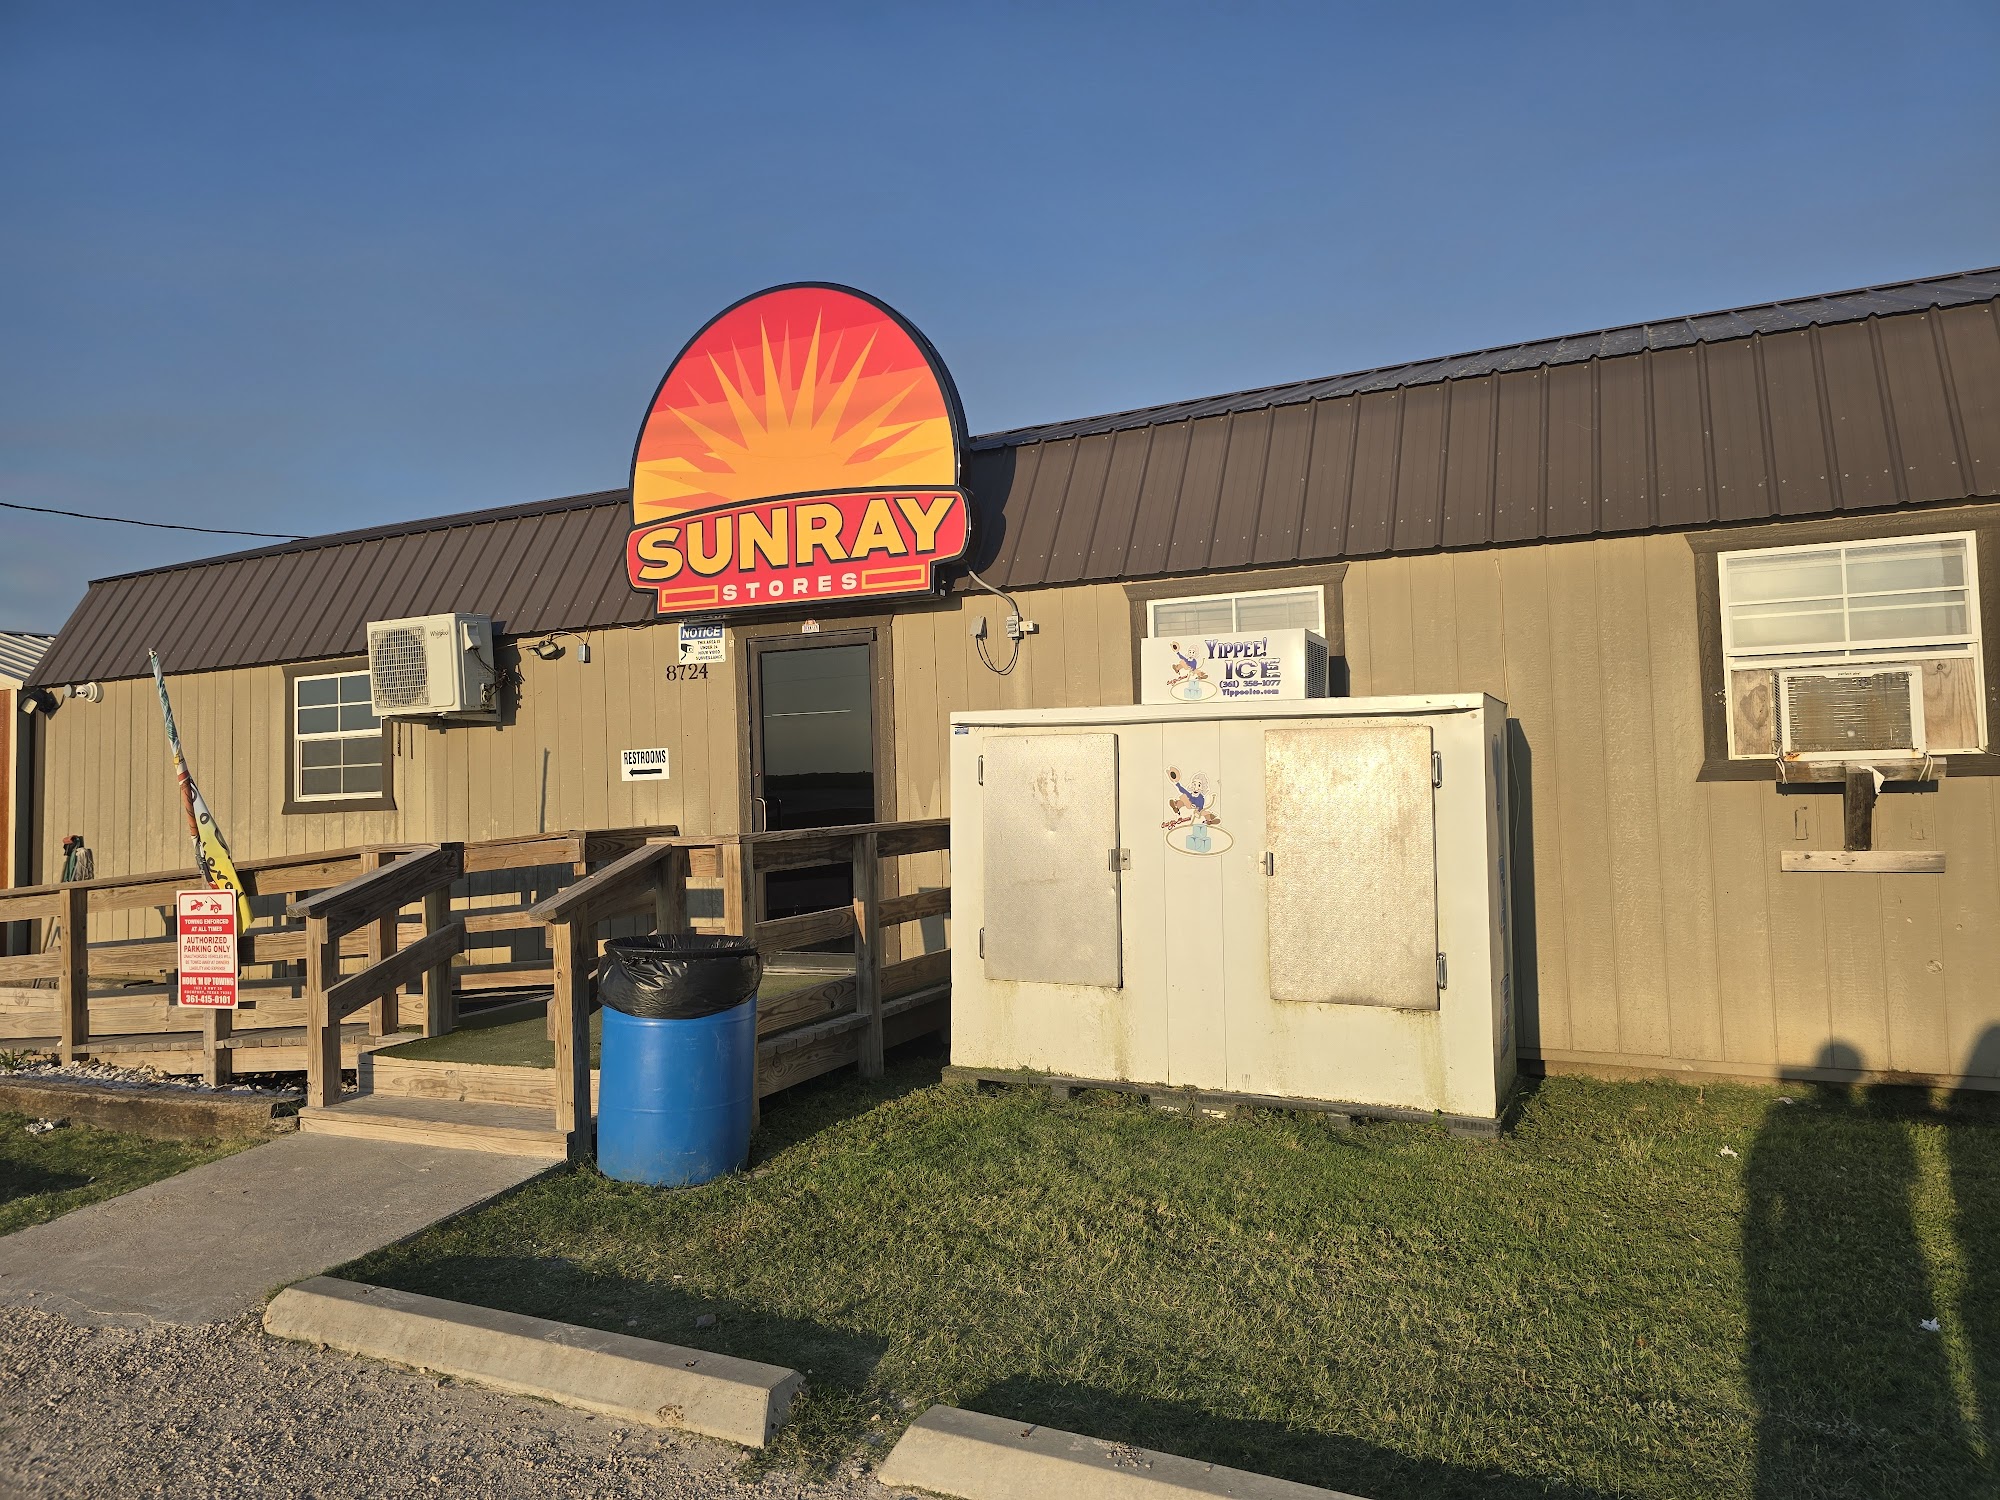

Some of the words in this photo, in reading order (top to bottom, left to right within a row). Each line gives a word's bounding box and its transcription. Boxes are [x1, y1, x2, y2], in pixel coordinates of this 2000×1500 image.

[637, 497, 957, 582] SUNRAY
[722, 572, 857, 601] STORES
[682, 626, 720, 639] NOTICE
[666, 663, 708, 681] 8724
[1225, 658, 1281, 680] ICE
[1219, 680, 1240, 688] (361)
[623, 750, 666, 765] RESTROOMS
[186, 936, 228, 944] AUTHORIZED
[181, 976, 197, 985] HOOK
[204, 977, 212, 985] UP
[212, 977, 234, 986] TOWING
[186, 994, 231, 1004] 361-415-0101
